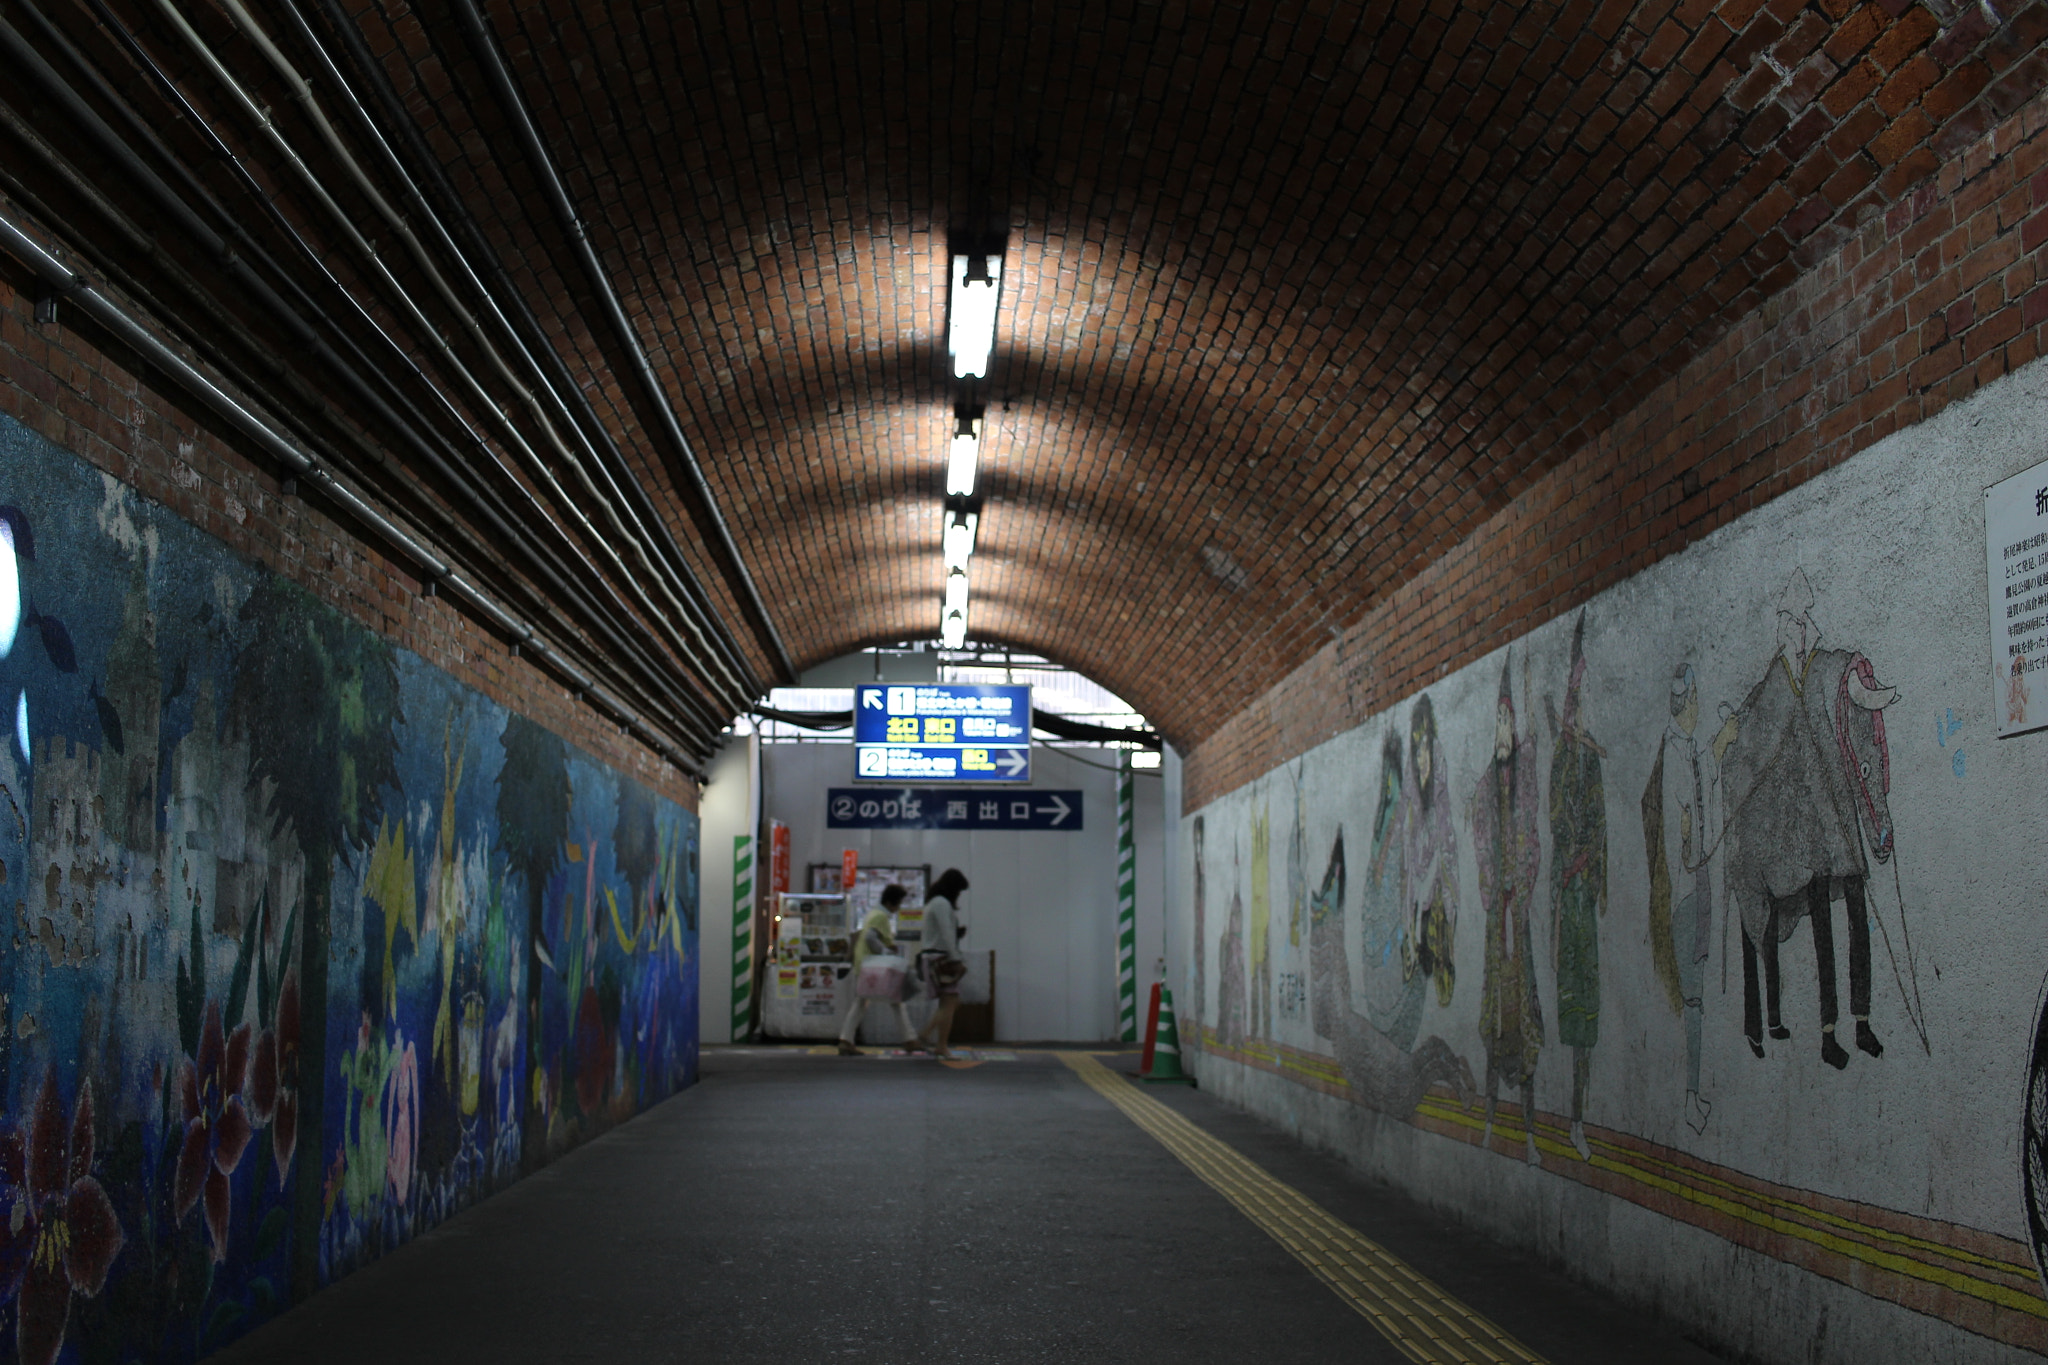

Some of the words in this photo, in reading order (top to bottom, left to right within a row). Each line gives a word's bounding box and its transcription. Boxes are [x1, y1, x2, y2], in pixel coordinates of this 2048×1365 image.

[2011, 654, 2048, 677] 名乗り出て子
[865, 752, 880, 772] 2
[947, 800, 1031, 821] 西出口
